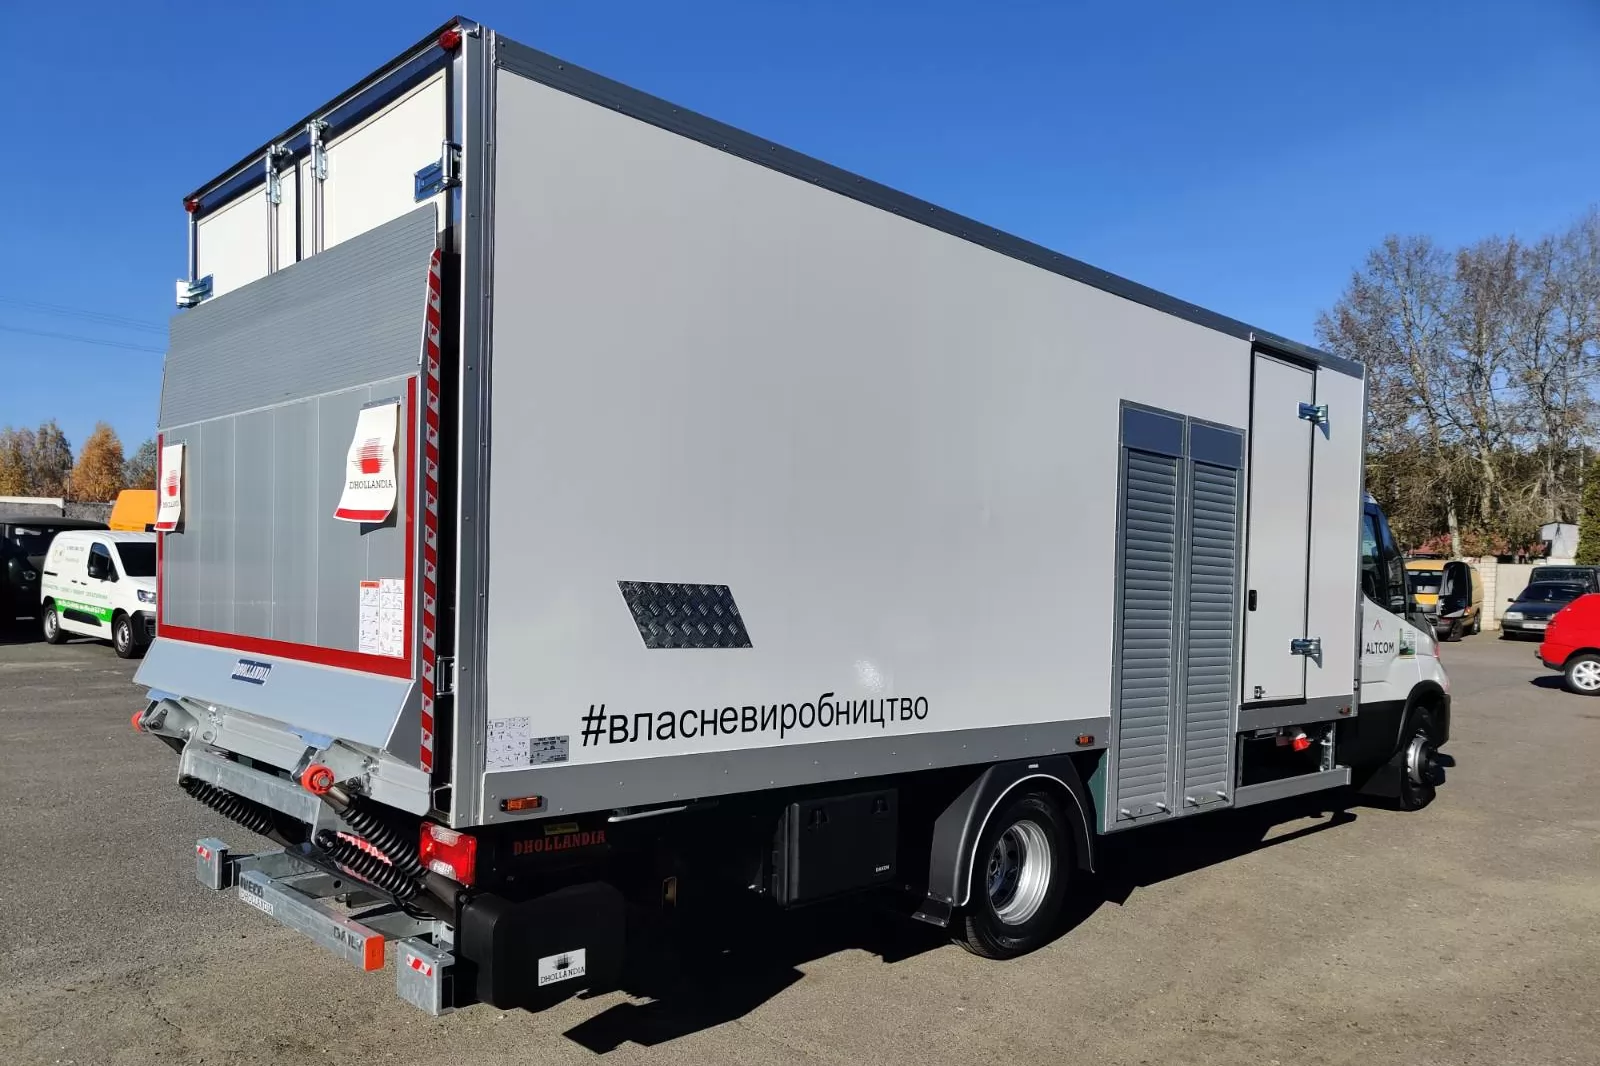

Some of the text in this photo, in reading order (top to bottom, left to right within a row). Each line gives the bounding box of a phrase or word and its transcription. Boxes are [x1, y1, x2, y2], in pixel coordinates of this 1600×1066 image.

[349, 479, 394, 490] DHOLLANDIA
[1365, 641, 1395, 655] ALTCOM
[581, 692, 929, 747] #власневиробництво
[513, 830, 606, 856] DHOLLANDIA
[240, 876, 264, 899] IVECO
[333, 925, 363, 951] DAILY
[540, 966, 585, 984] DHOLLANDIA
